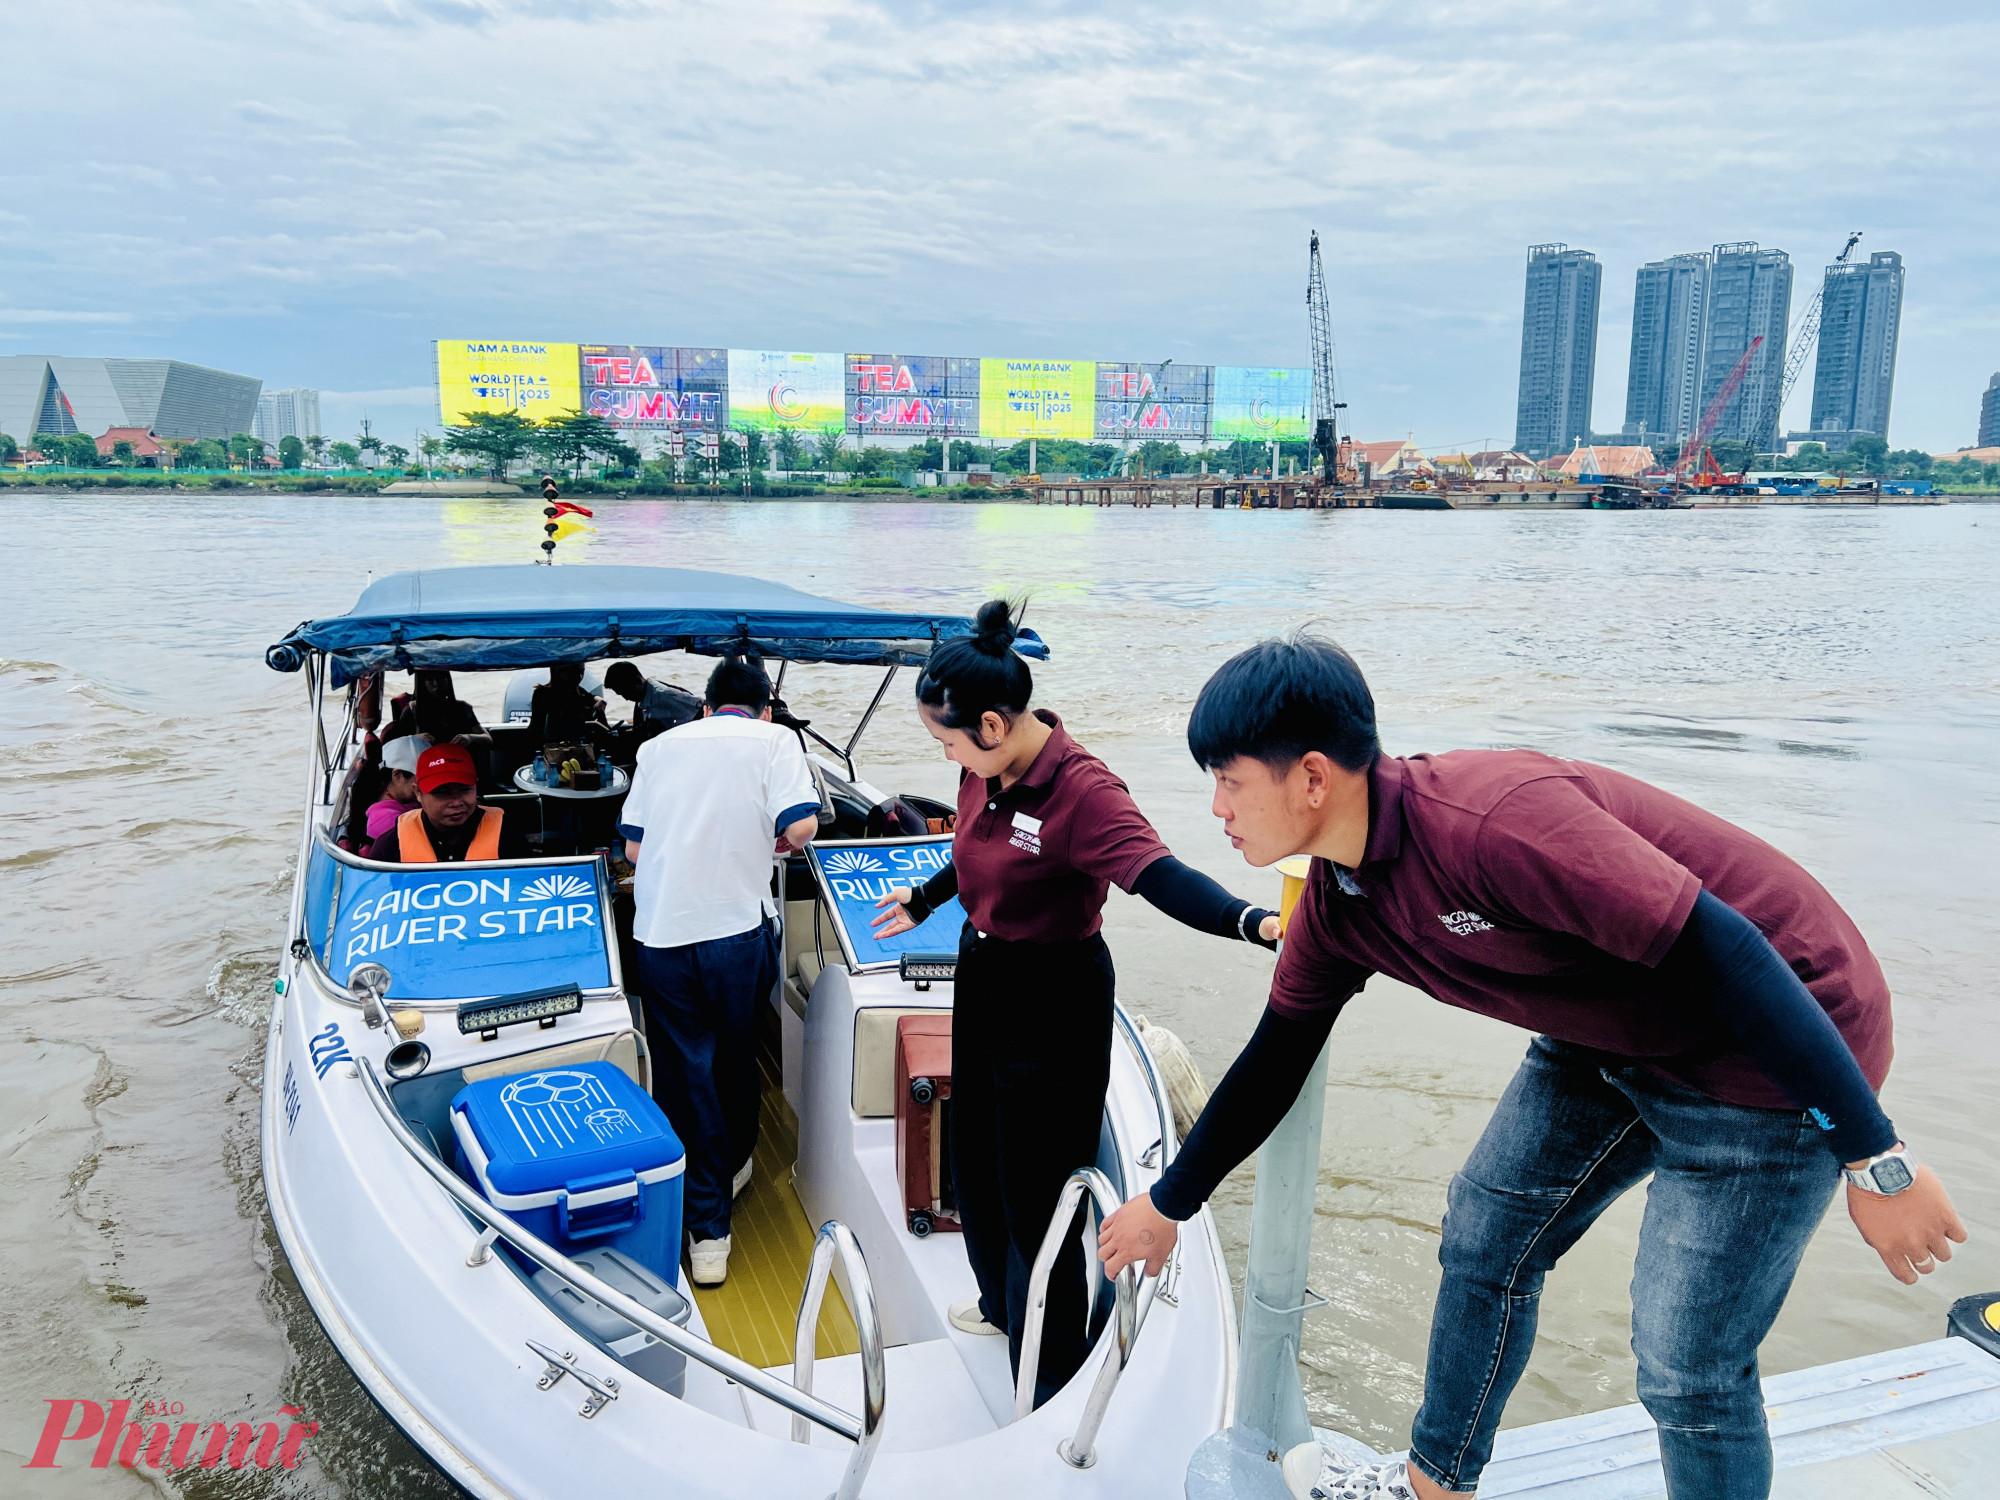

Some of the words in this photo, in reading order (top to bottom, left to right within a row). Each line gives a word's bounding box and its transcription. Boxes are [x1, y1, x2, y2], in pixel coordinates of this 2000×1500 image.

[467, 344, 498, 353] NAM
[500, 344, 509, 353] A
[512, 344, 548, 354] BANK
[469, 374, 511, 384] WORLD
[584, 355, 659, 386] TEA
[850, 364, 918, 393] TEA
[1006, 362, 1032, 371] NAM
[1033, 363, 1040, 371] A
[1042, 363, 1072, 372] BANK
[1007, 389, 1040, 399] WORLD
[1100, 372, 1159, 399] TEA
[587, 389, 721, 421] SUMMIT
[851, 395, 973, 426] SUMMIT
[1099, 402, 1208, 430] SUMMIT
[1023, 843, 1040, 855] STAR
[350, 878, 510, 932] SAIGON
[345, 914, 468, 967] RIVER
[479, 903, 597, 939] STAR
[309, 1022, 353, 1081] 22K
